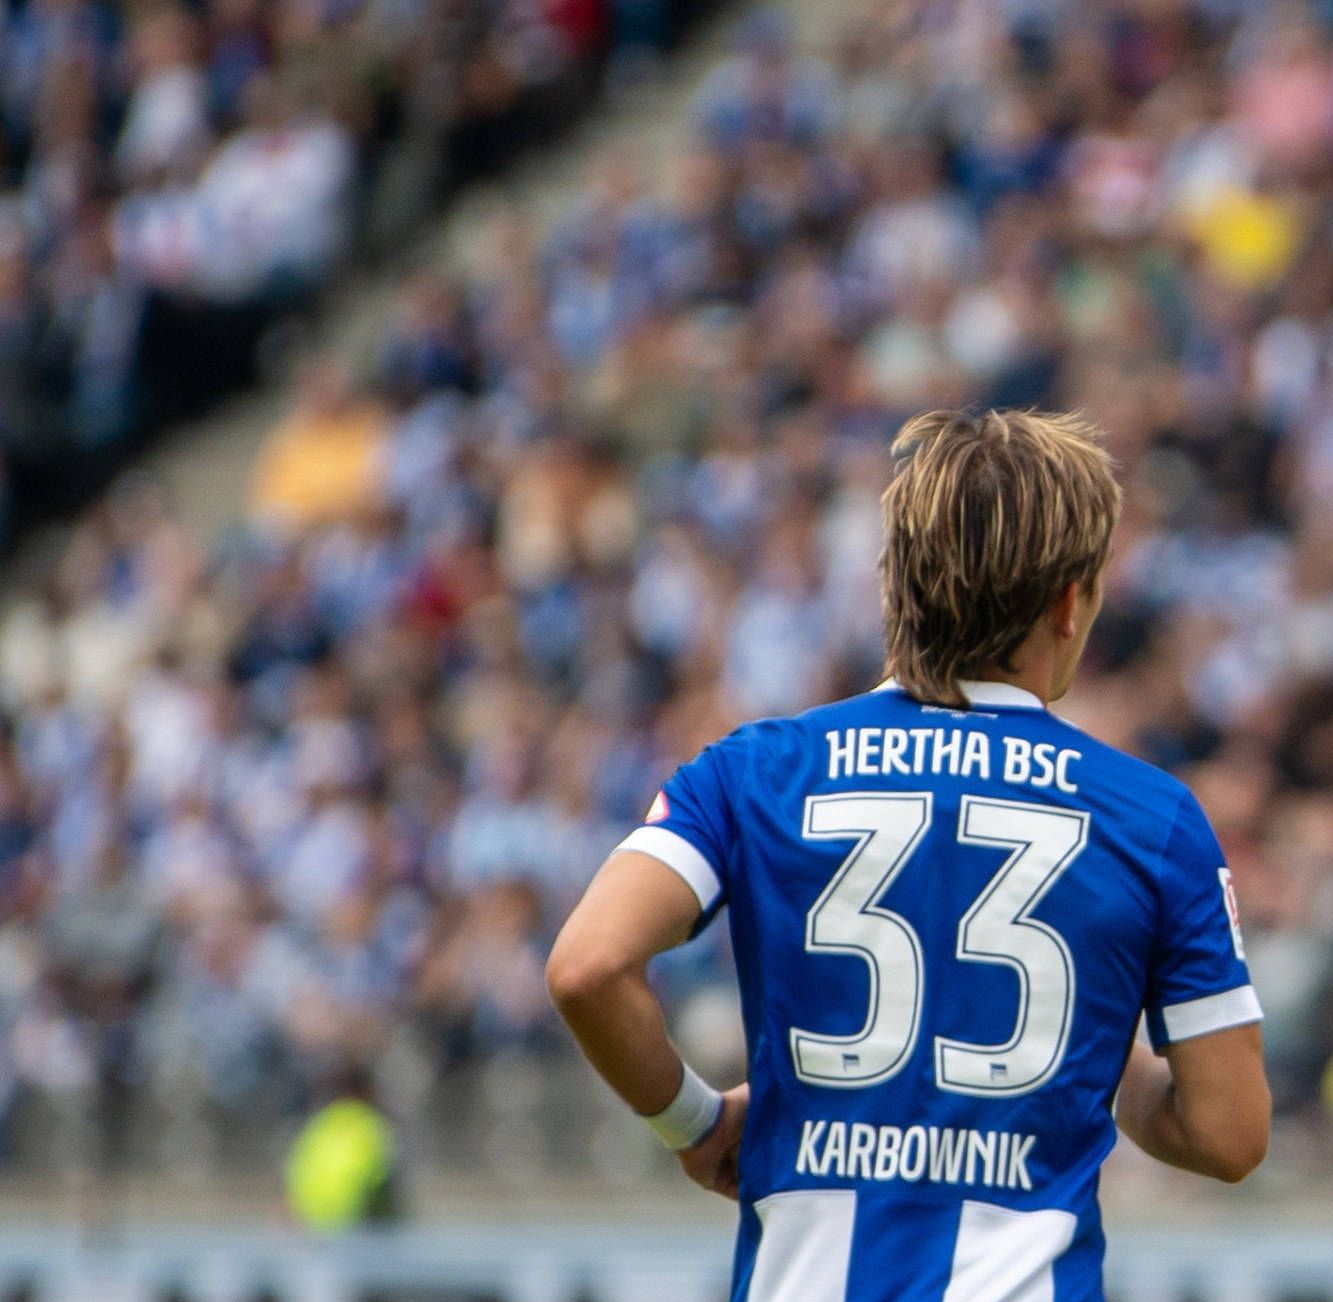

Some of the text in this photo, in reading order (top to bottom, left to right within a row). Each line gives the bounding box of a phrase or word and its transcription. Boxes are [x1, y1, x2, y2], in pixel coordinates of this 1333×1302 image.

[826, 727, 1082, 794] HERTHA BSC
[789, 790, 1092, 1099] 33
[796, 1120, 1036, 1190] KARBOWNIK
